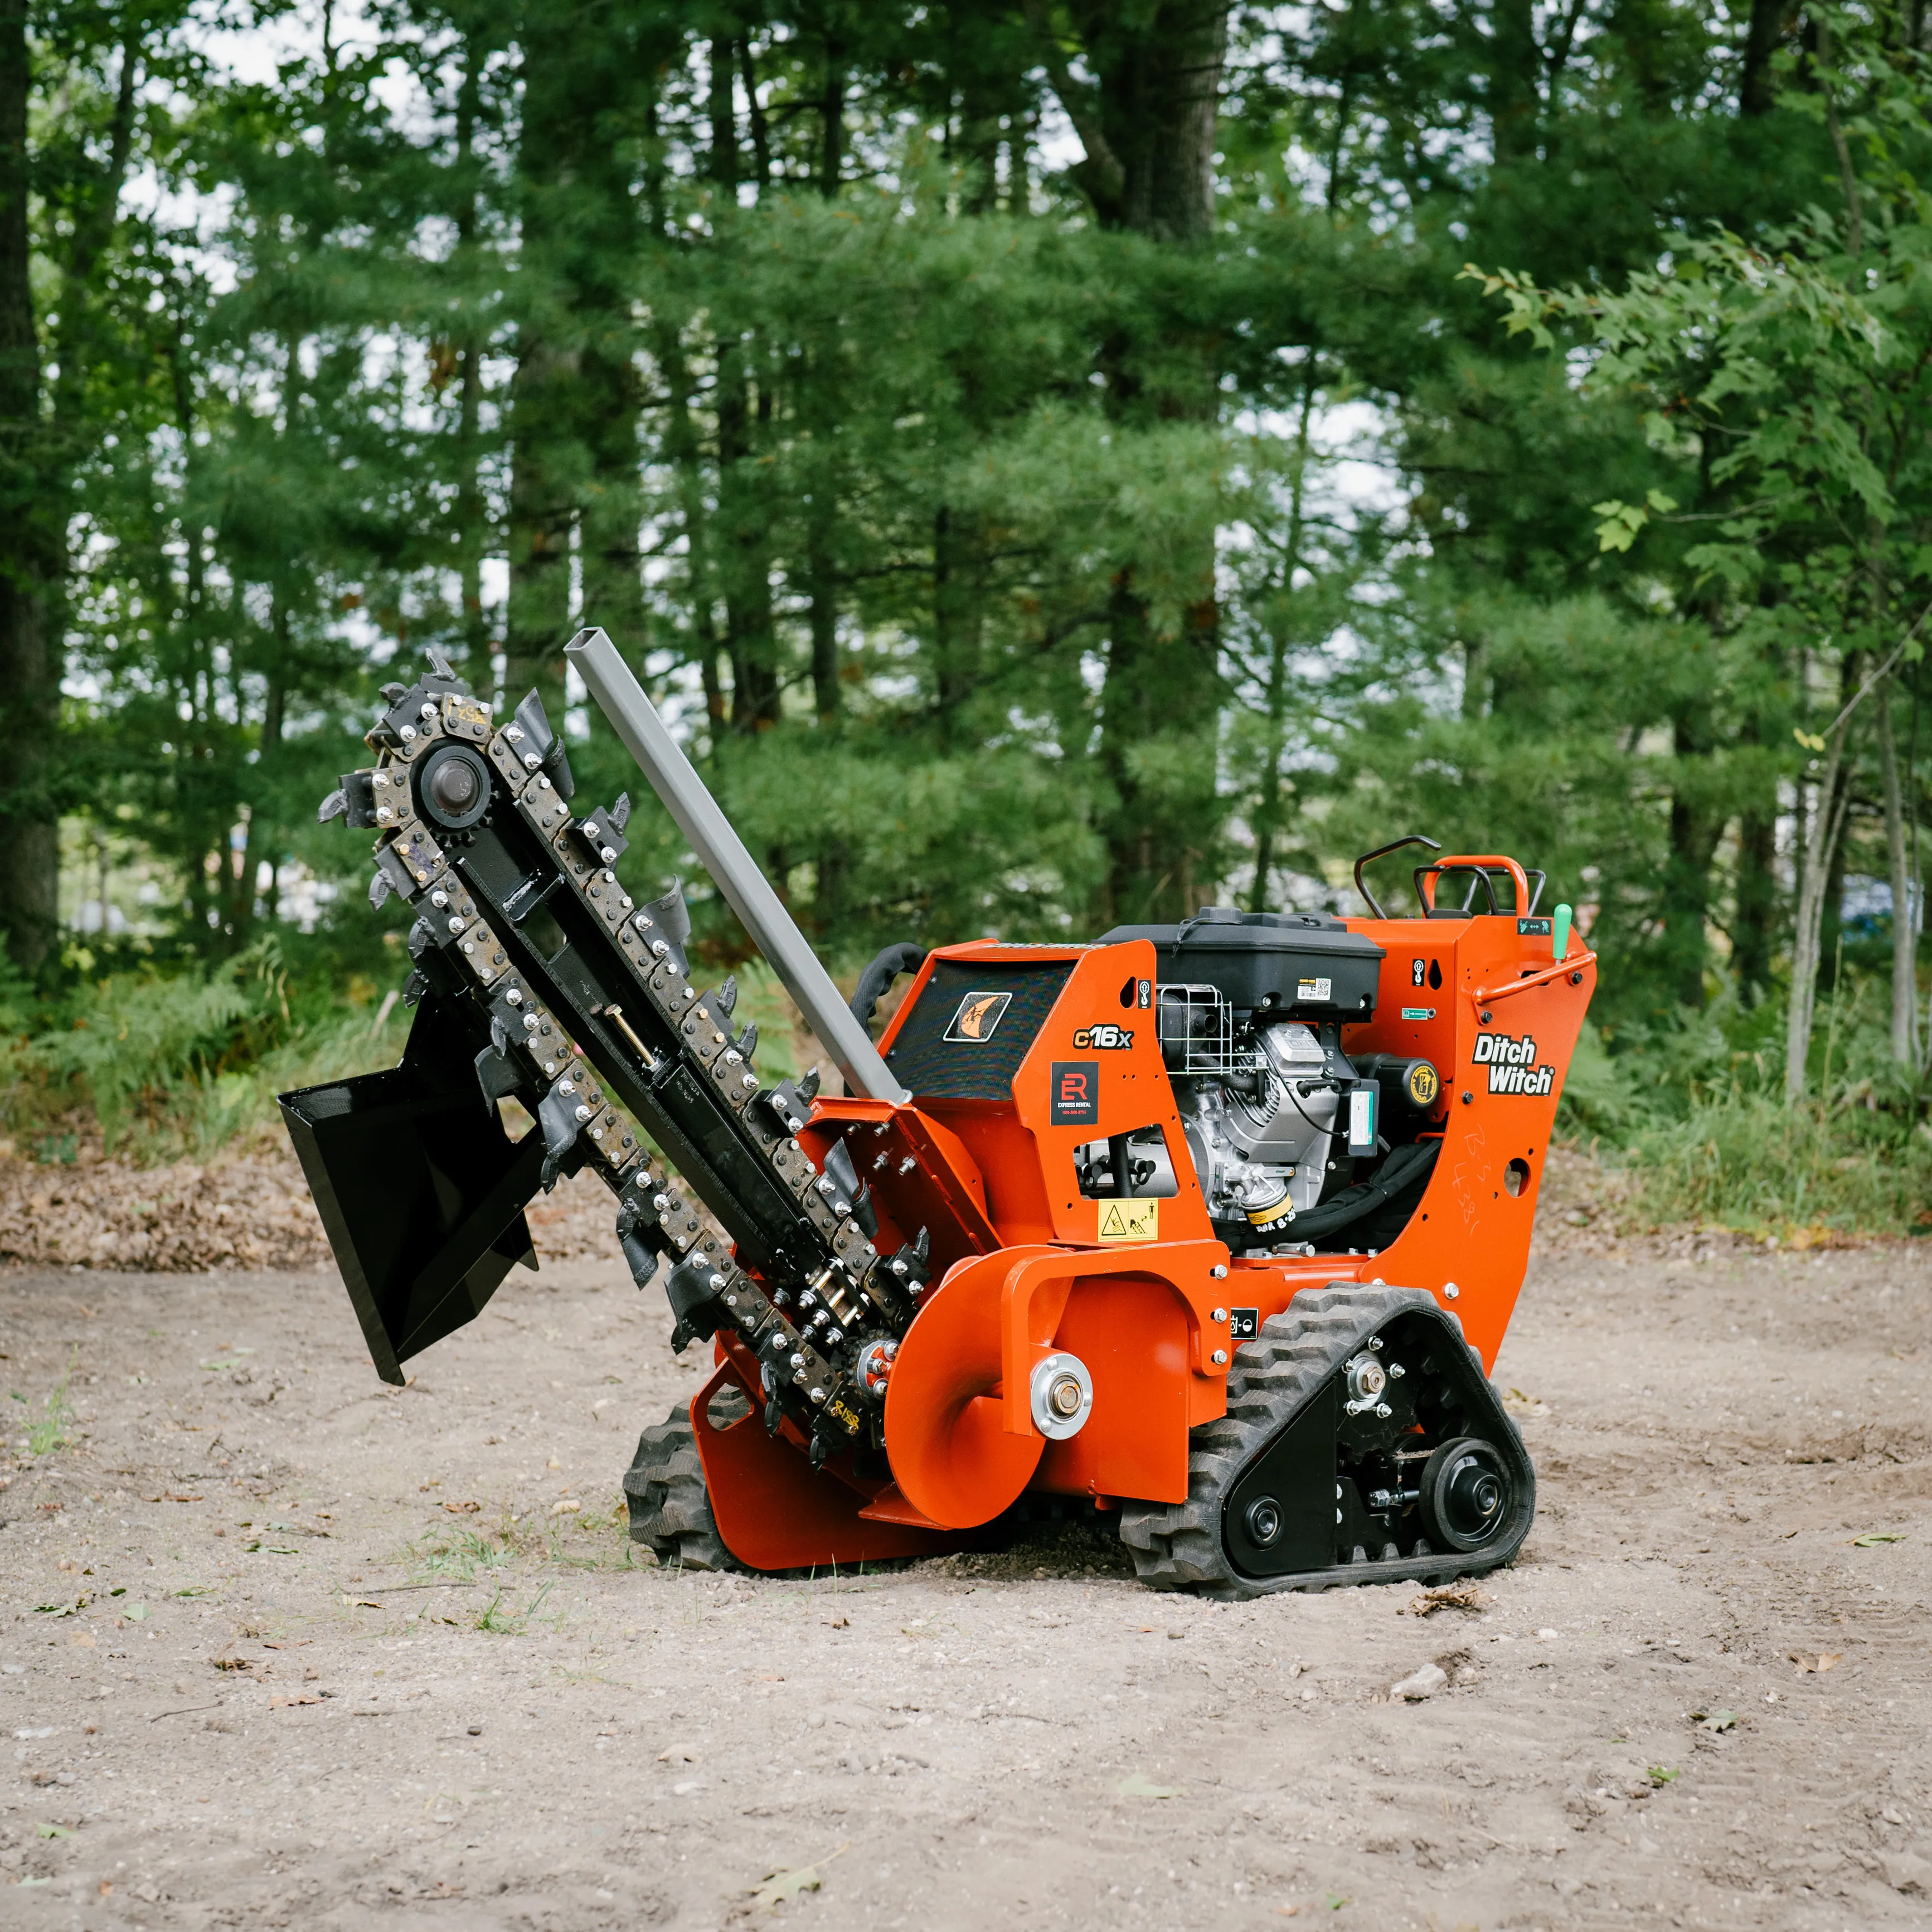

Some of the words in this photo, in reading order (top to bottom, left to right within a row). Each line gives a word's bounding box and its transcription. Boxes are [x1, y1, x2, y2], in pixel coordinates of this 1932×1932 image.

[1474, 1035, 1536, 1064] Ditch
[1061, 1073, 1088, 1100] ER
[1414, 1067, 1429, 1078] MANUAL
[1489, 1065, 1552, 1094] Witch
